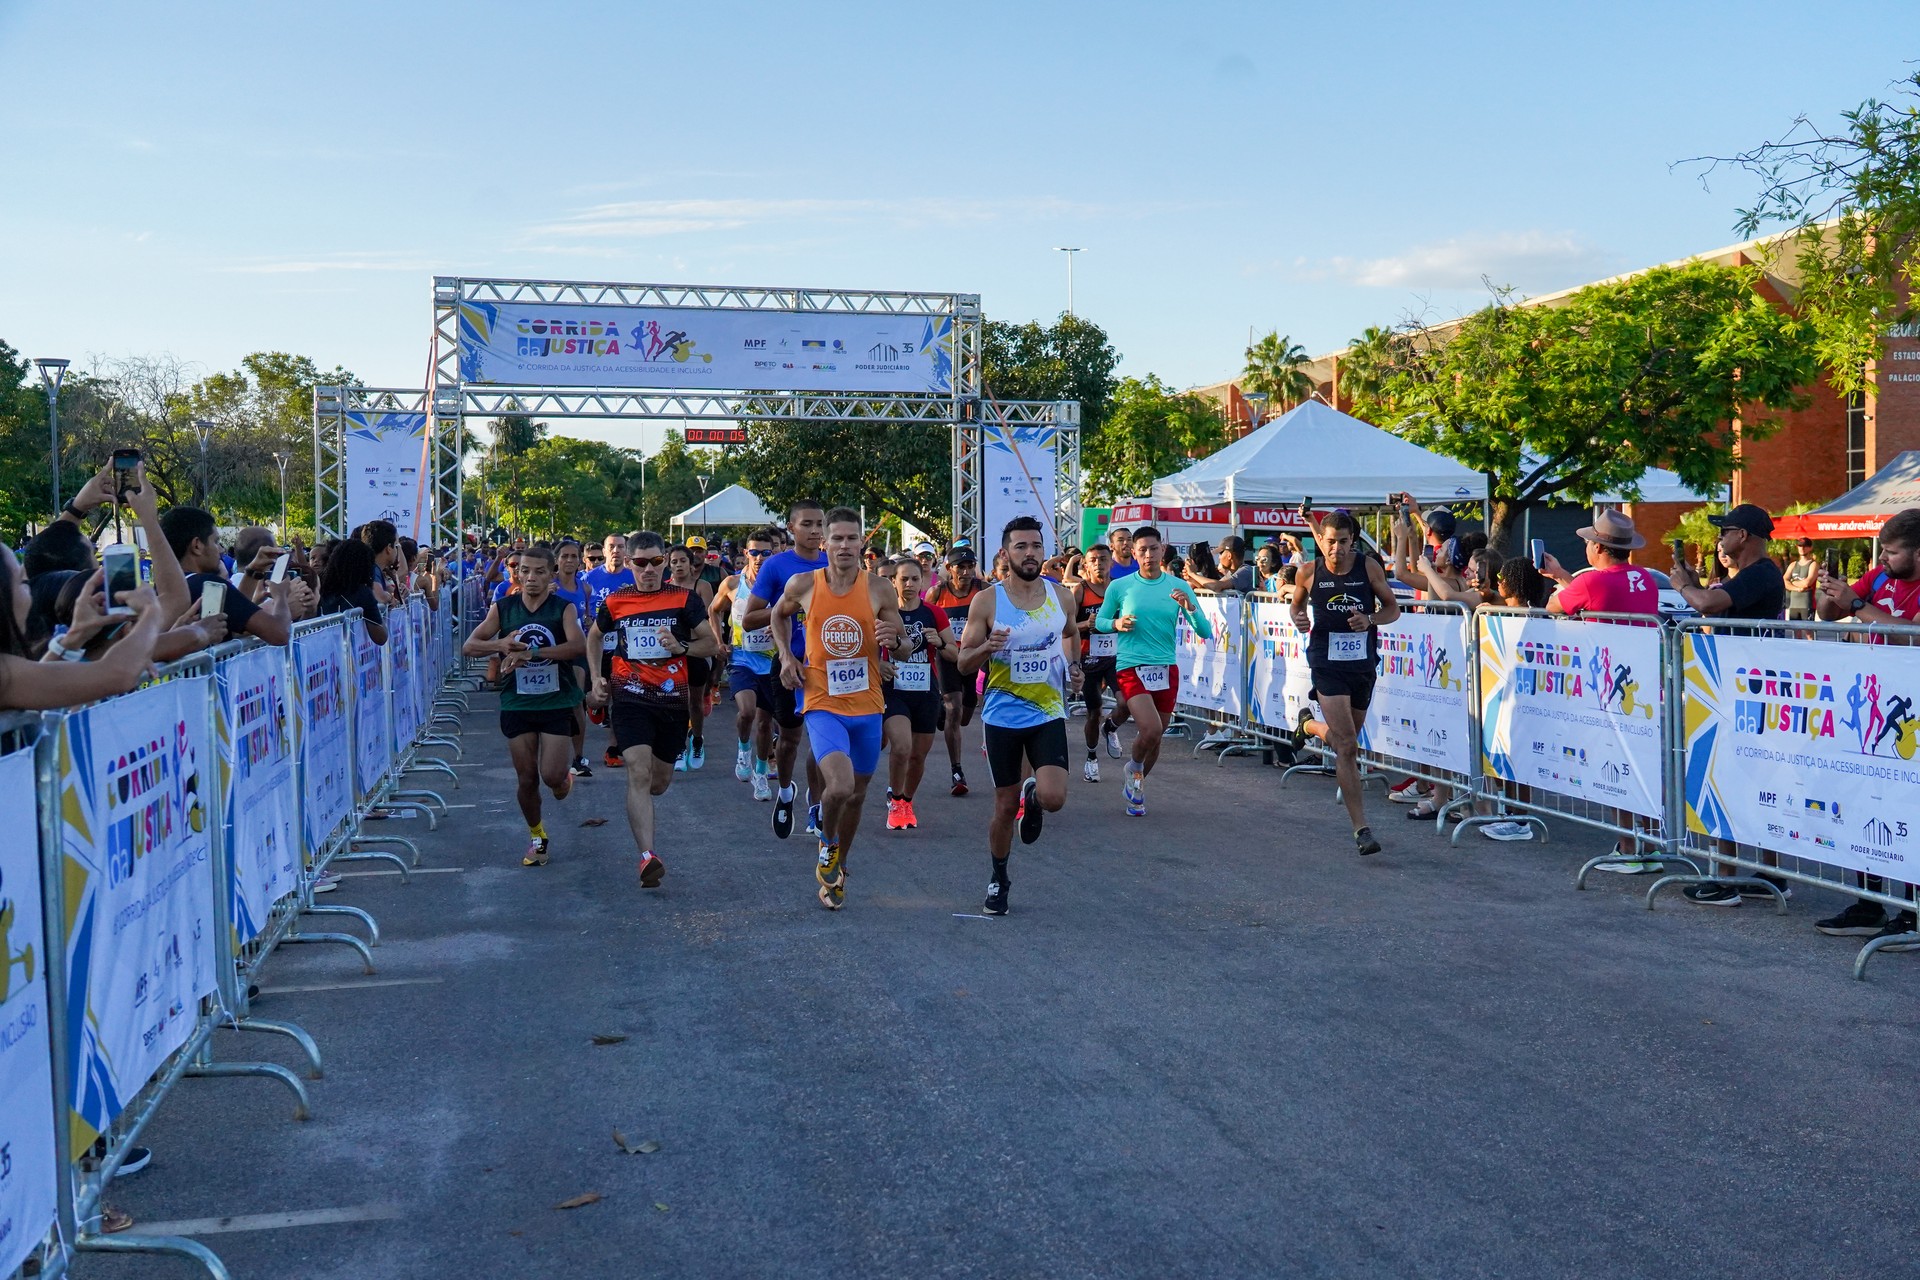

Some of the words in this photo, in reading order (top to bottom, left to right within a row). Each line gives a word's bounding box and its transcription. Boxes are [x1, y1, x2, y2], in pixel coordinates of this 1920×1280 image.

[517, 318, 620, 337] CORRIDA
[538, 337, 620, 358] JUSTIÇA
[743, 339, 767, 348] MPF
[902, 342, 914, 354] 35
[572, 365, 602, 373] JUSTIÇA
[1181, 507, 1213, 521] UTI
[631, 617, 645, 627] de
[647, 617, 677, 627] Poeira
[746, 634, 771, 644] 1322
[825, 631, 860, 643] PEREIRA
[1376, 631, 1414, 653] ORRIDA
[1098, 639, 1113, 649] 751
[1334, 640, 1362, 651] 1265
[1515, 641, 1582, 669] CORRIDA
[1013, 660, 1048, 673] 1390
[1380, 654, 1415, 680] JUSTIÇA
[521, 673, 551, 685] 1421
[830, 667, 865, 682] 1604
[899, 670, 926, 681] 1302
[1141, 671, 1164, 683] 1404
[1529, 668, 1582, 700] JUSTIÇA
[1735, 667, 1835, 702] CORRIDA
[1736, 700, 1757, 733] da
[1756, 702, 1835, 741] JUSTIÇA
[1532, 741, 1544, 751] MPF
[1621, 763, 1630, 775] 35
[1744, 746, 1774, 761] CORRIDA
[1775, 751, 1787, 762] DA
[1787, 752, 1816, 769] JUSTIÇA
[1817, 757, 1829, 770] DA
[1830, 759, 1892, 781] ACESSIBILIDADE
[1893, 769, 1899, 781] E
[107, 736, 169, 810] CORRIDA
[1592, 782, 1606, 791] PODER
[1759, 790, 1777, 804] MPF
[1895, 821, 1908, 837] 35
[1851, 844, 1870, 855] PODER
[1871, 848, 1904, 862] JUDICIÁRIO
